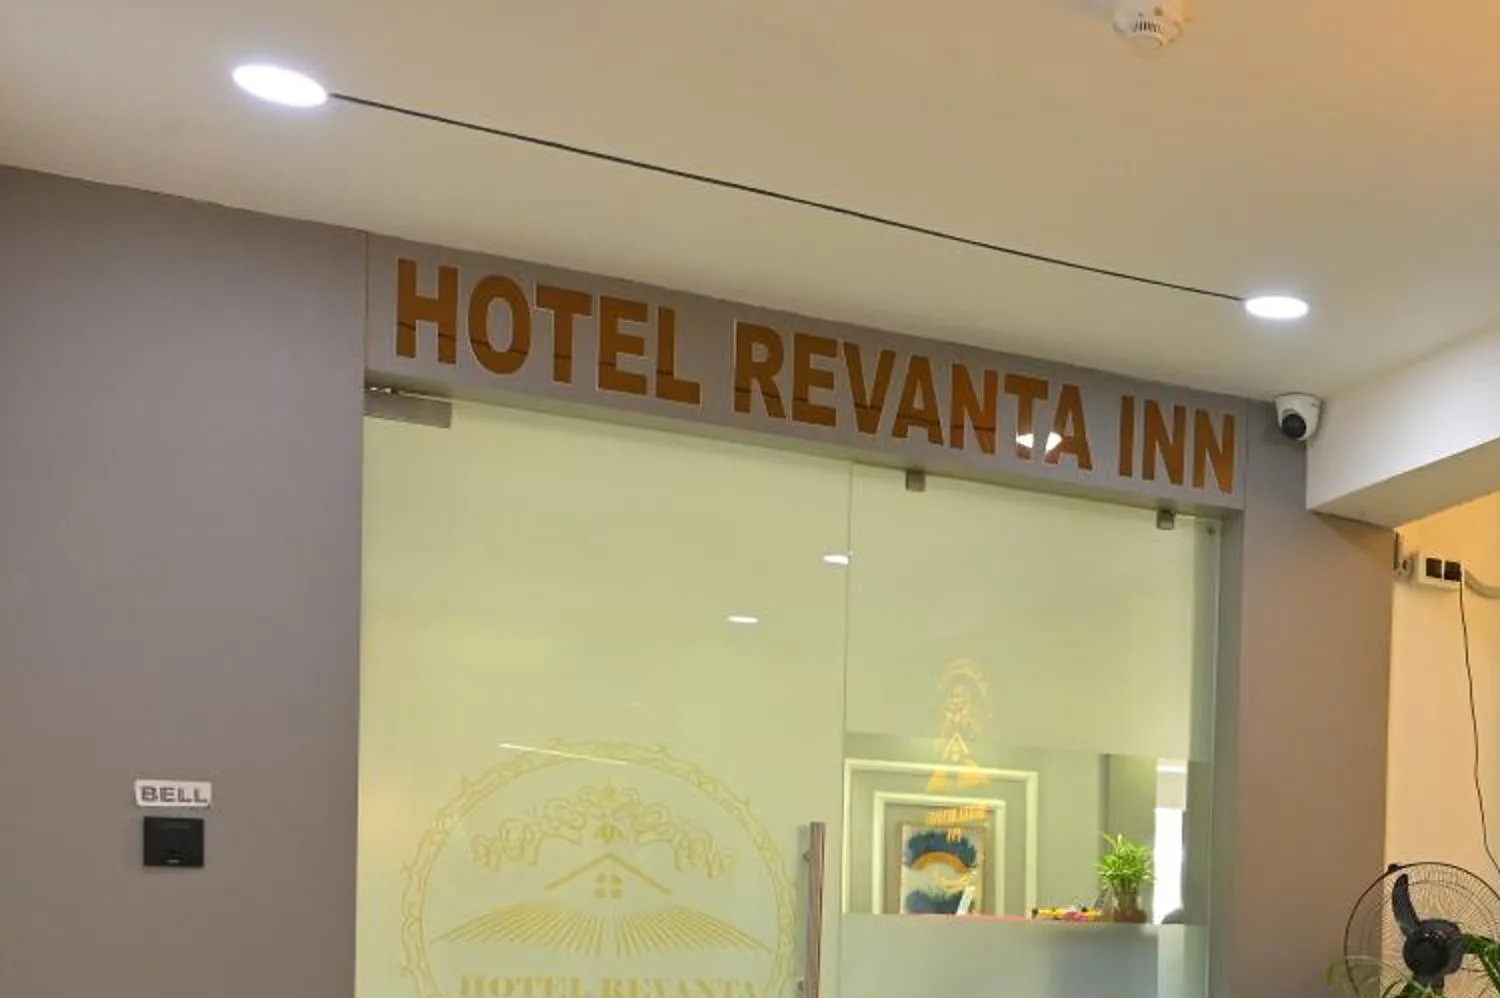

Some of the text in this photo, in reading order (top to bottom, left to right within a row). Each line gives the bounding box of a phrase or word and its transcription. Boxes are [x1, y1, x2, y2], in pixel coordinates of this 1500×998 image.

[395, 257, 1237, 495] HOTEL REVANTA INN
[141, 785, 209, 803] BELL
